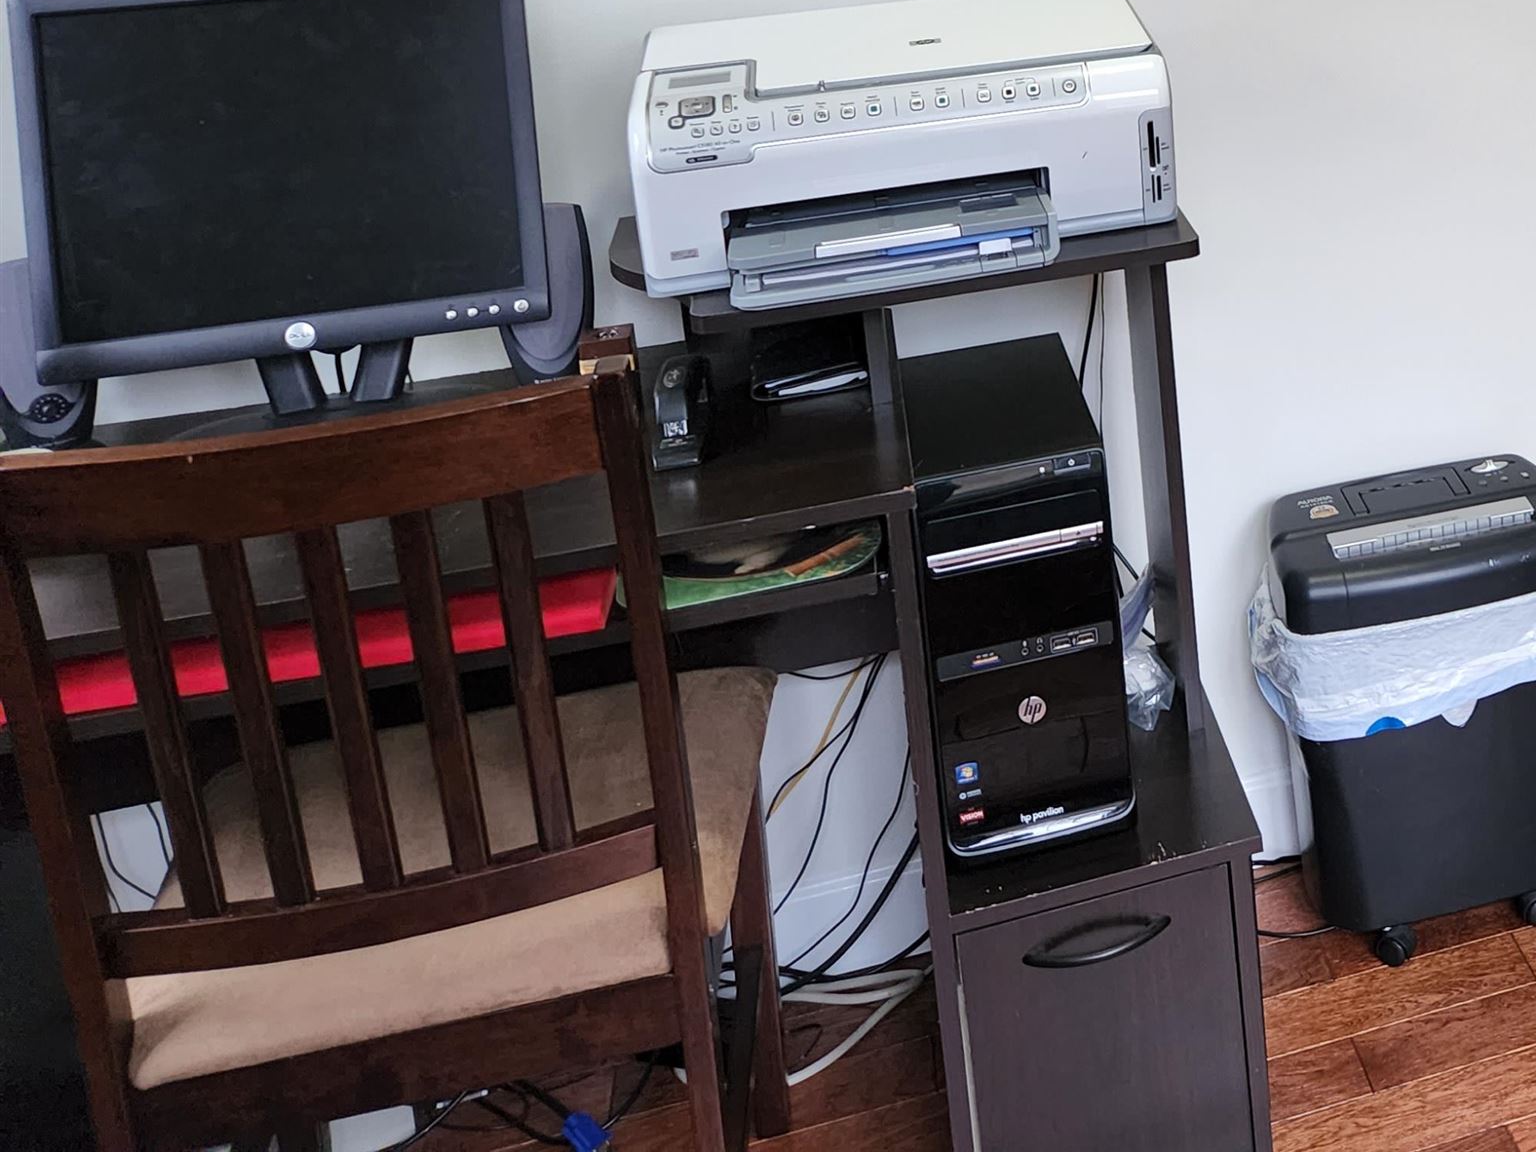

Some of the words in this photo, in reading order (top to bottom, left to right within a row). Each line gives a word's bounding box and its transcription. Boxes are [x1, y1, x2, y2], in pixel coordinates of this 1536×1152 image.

[1021, 697, 1043, 723] hp
[1020, 812, 1032, 825] hp
[1032, 806, 1065, 822] pavilion
